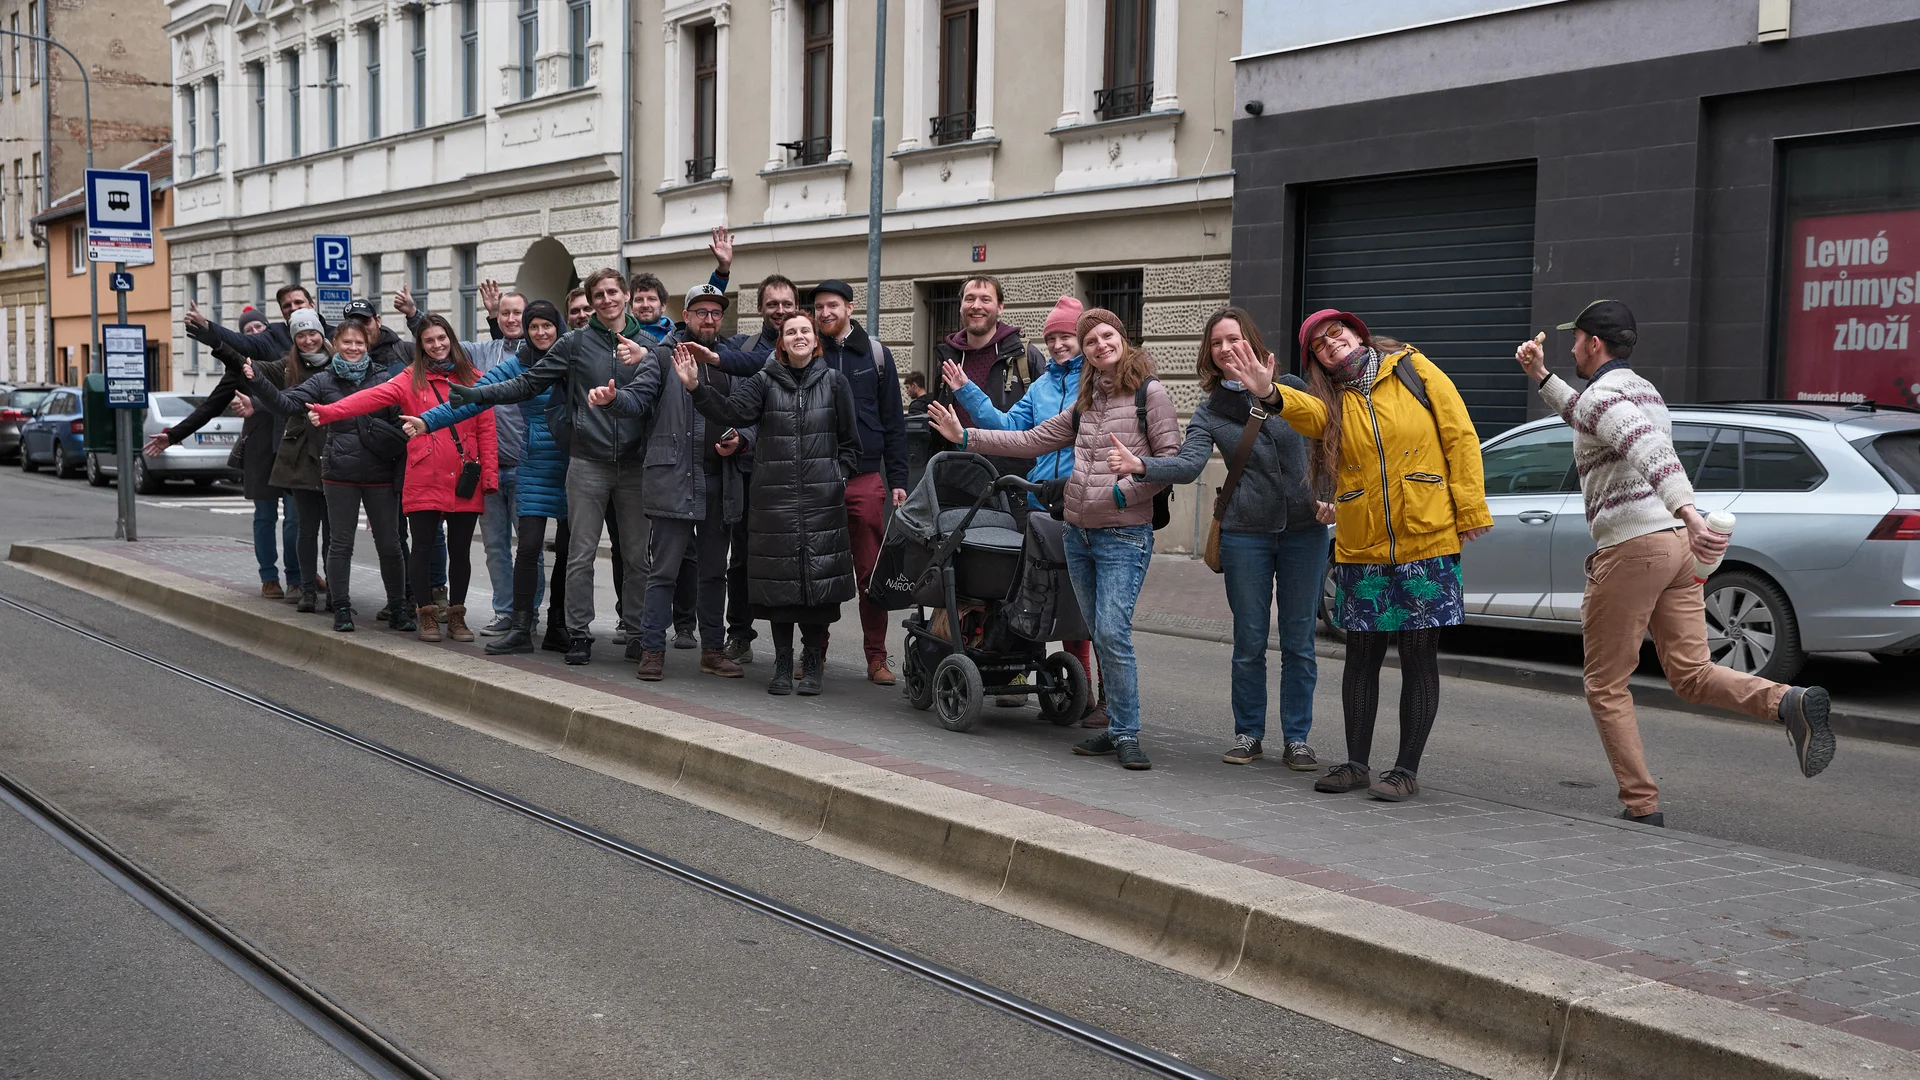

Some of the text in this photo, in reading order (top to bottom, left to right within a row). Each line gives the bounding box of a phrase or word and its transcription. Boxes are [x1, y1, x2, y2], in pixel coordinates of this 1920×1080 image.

[323, 241, 344, 270] P
[1805, 230, 1888, 268] Levné
[1833, 315, 1911, 350] zboží
[1798, 391, 1839, 402] Otevírací
